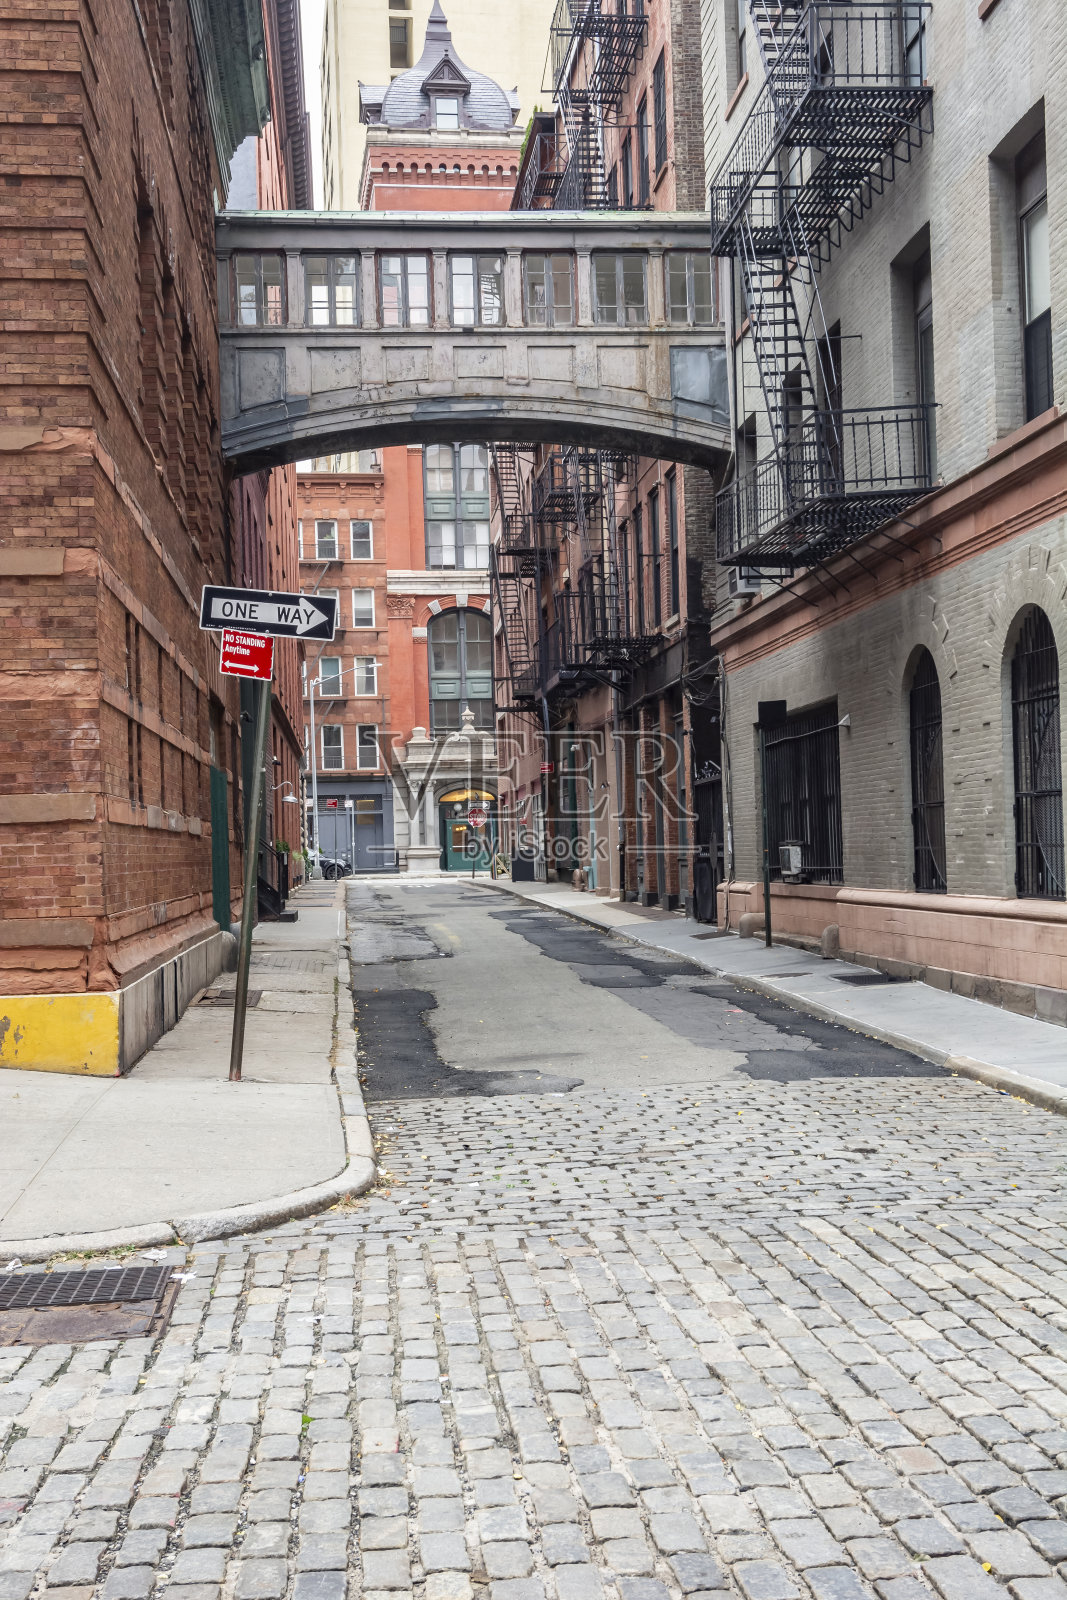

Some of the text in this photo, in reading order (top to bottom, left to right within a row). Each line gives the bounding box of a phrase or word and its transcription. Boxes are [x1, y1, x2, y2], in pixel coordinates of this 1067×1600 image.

[222, 601, 316, 625] ONE WAY
[225, 633, 266, 648] NO STANDING
[224, 643, 251, 655] Anytime
[469, 813, 486, 821] STOP
